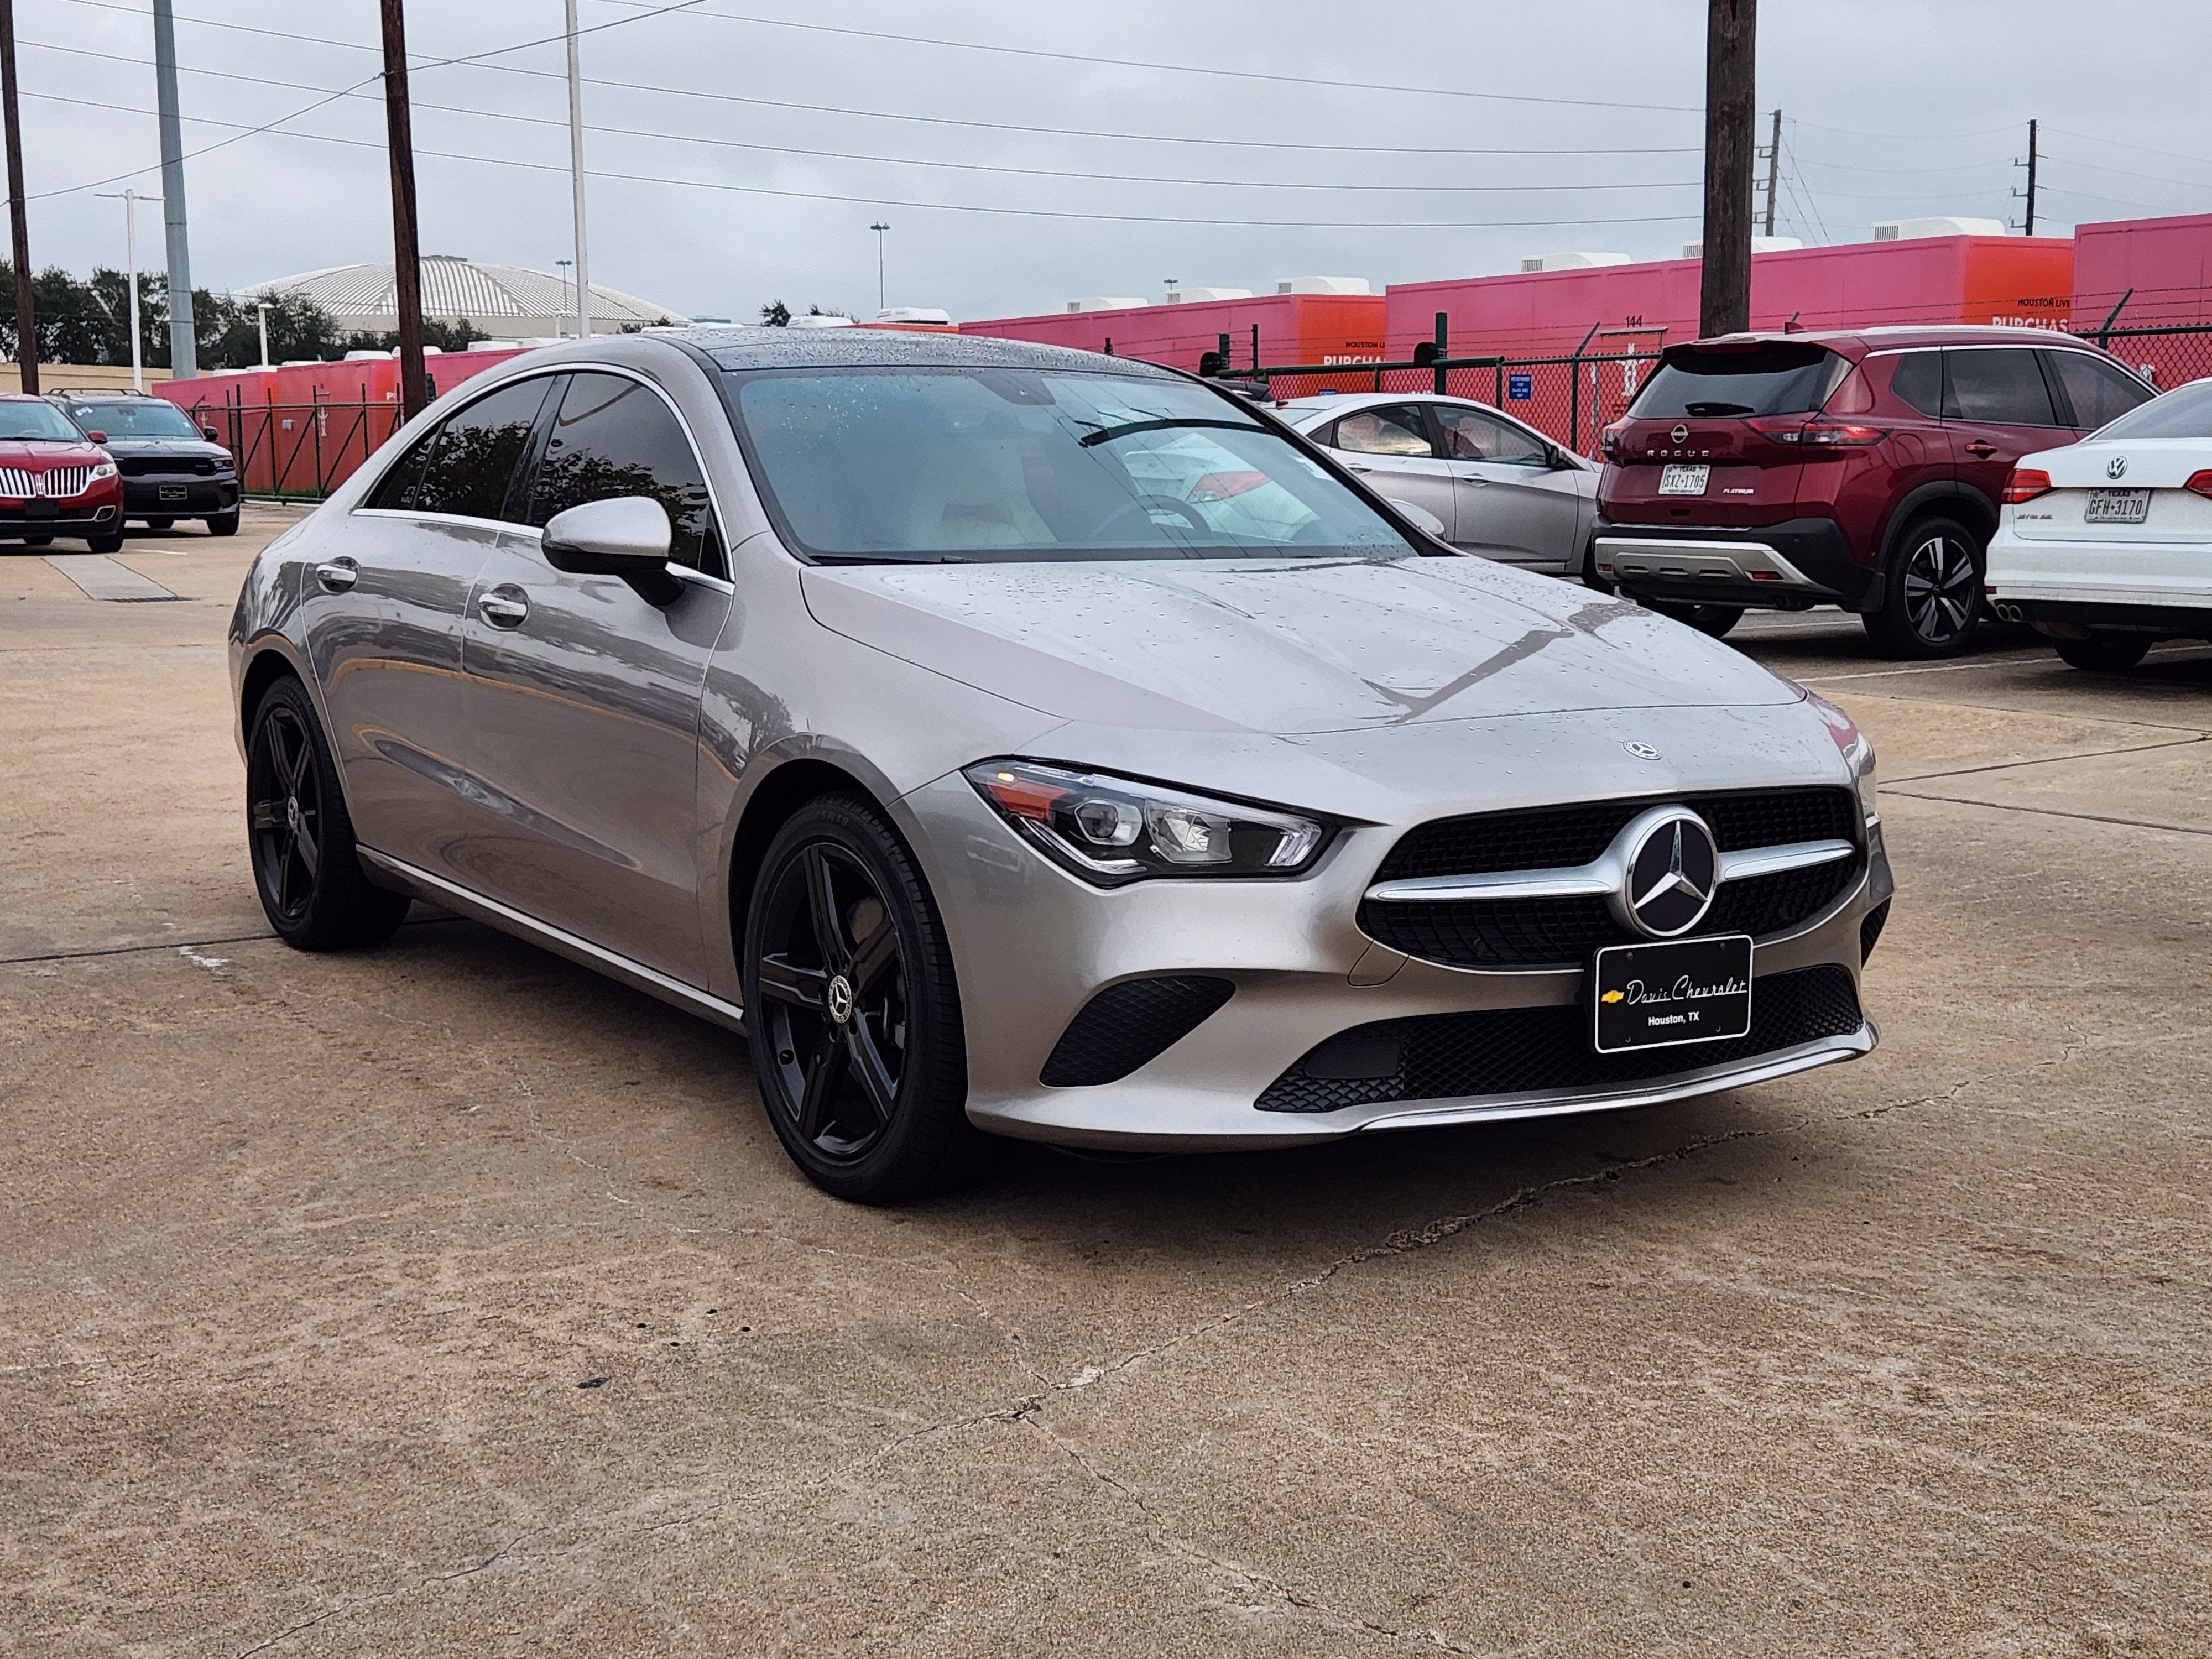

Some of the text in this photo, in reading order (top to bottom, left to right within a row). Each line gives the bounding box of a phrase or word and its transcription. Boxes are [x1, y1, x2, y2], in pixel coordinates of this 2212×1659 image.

[2018, 298, 2054, 307] HOUSTON
[1626, 315, 1642, 327] 144
[1626, 975, 1747, 1005] Davis Chevrolet
[1648, 1011, 1700, 1027] Houston, TX
